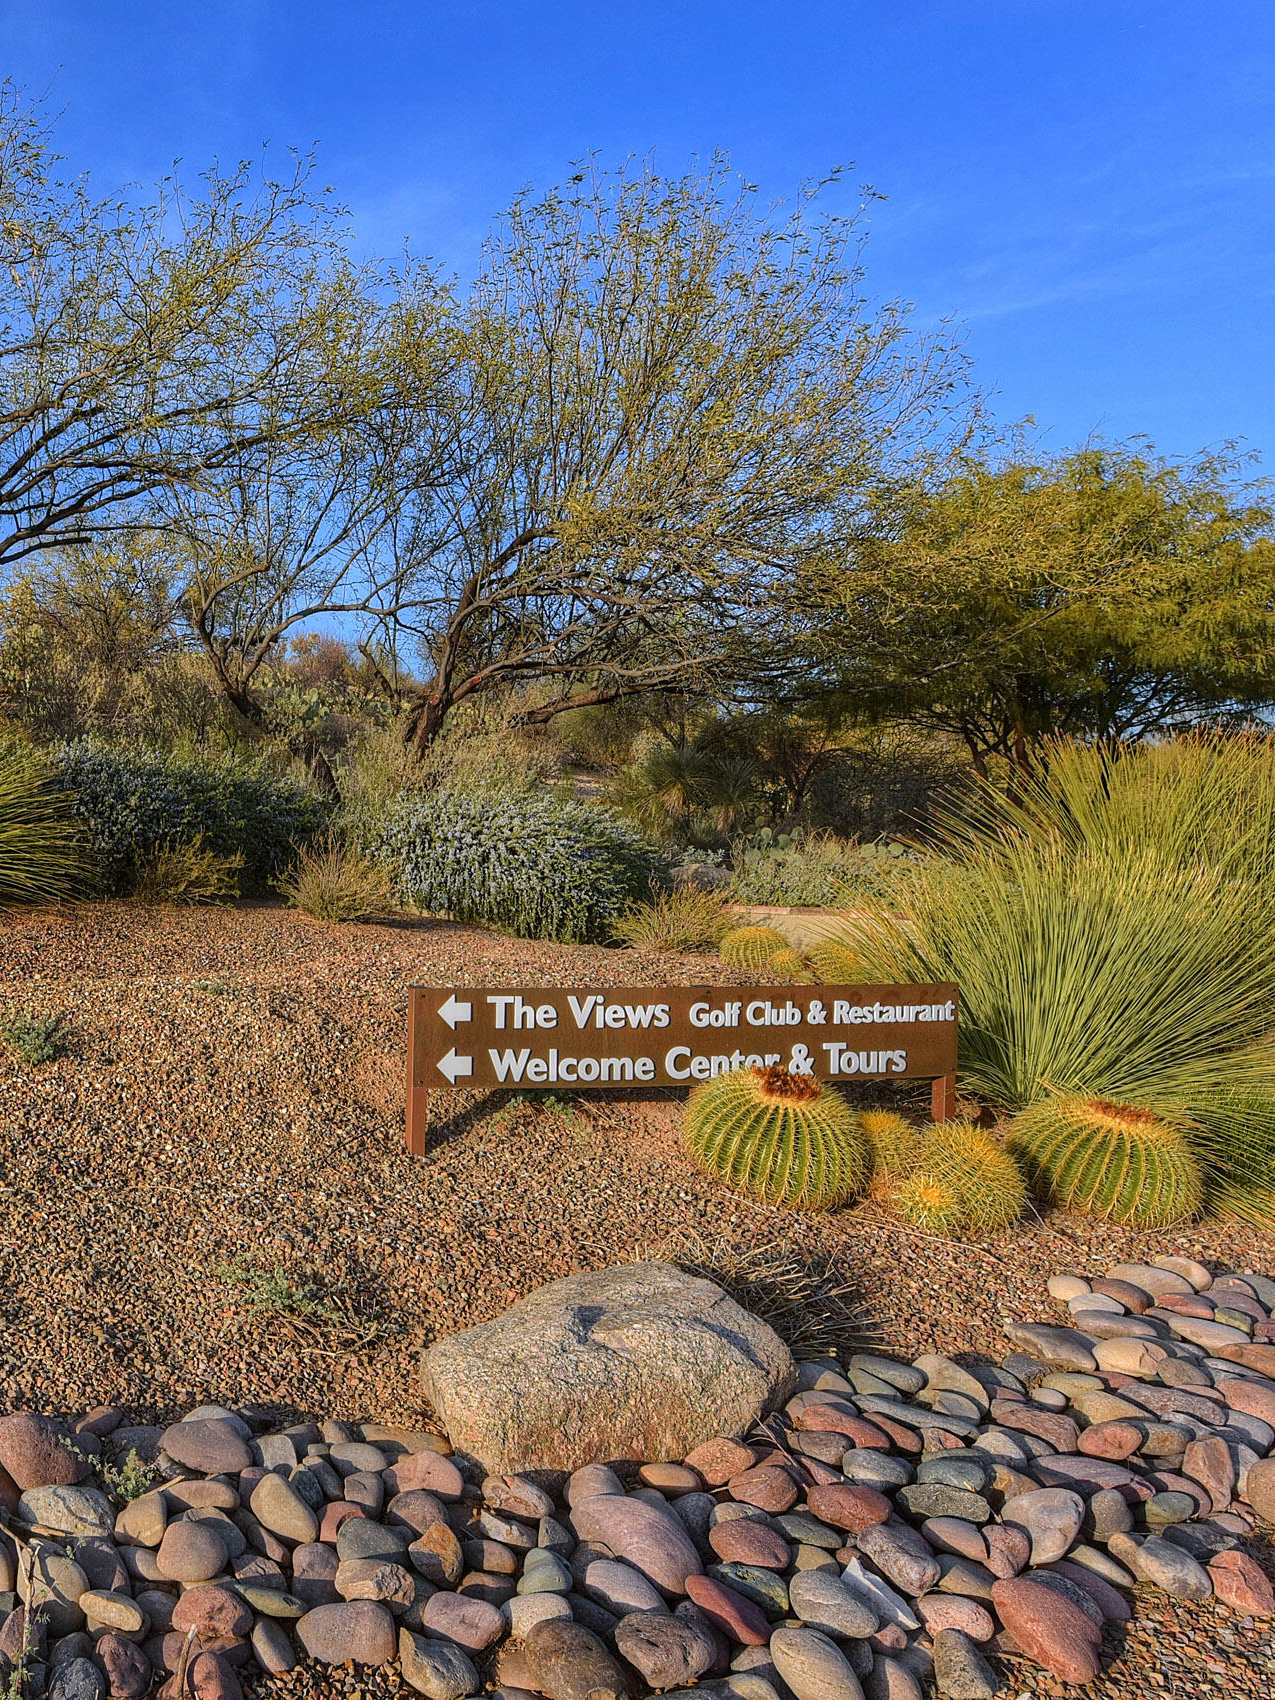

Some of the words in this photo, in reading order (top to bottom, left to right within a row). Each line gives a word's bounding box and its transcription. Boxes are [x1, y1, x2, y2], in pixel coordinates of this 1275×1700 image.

[487, 995, 558, 1030] The
[567, 994, 671, 1030] Views
[689, 1001, 742, 1027] Golf
[746, 1000, 803, 1026] Club
[807, 1000, 827, 1024] &
[833, 1000, 956, 1025] Restaurant
[488, 1048, 656, 1083] Welcome
[665, 1046, 781, 1080] Center
[788, 1043, 815, 1076] &
[823, 1042, 907, 1075] Tours
